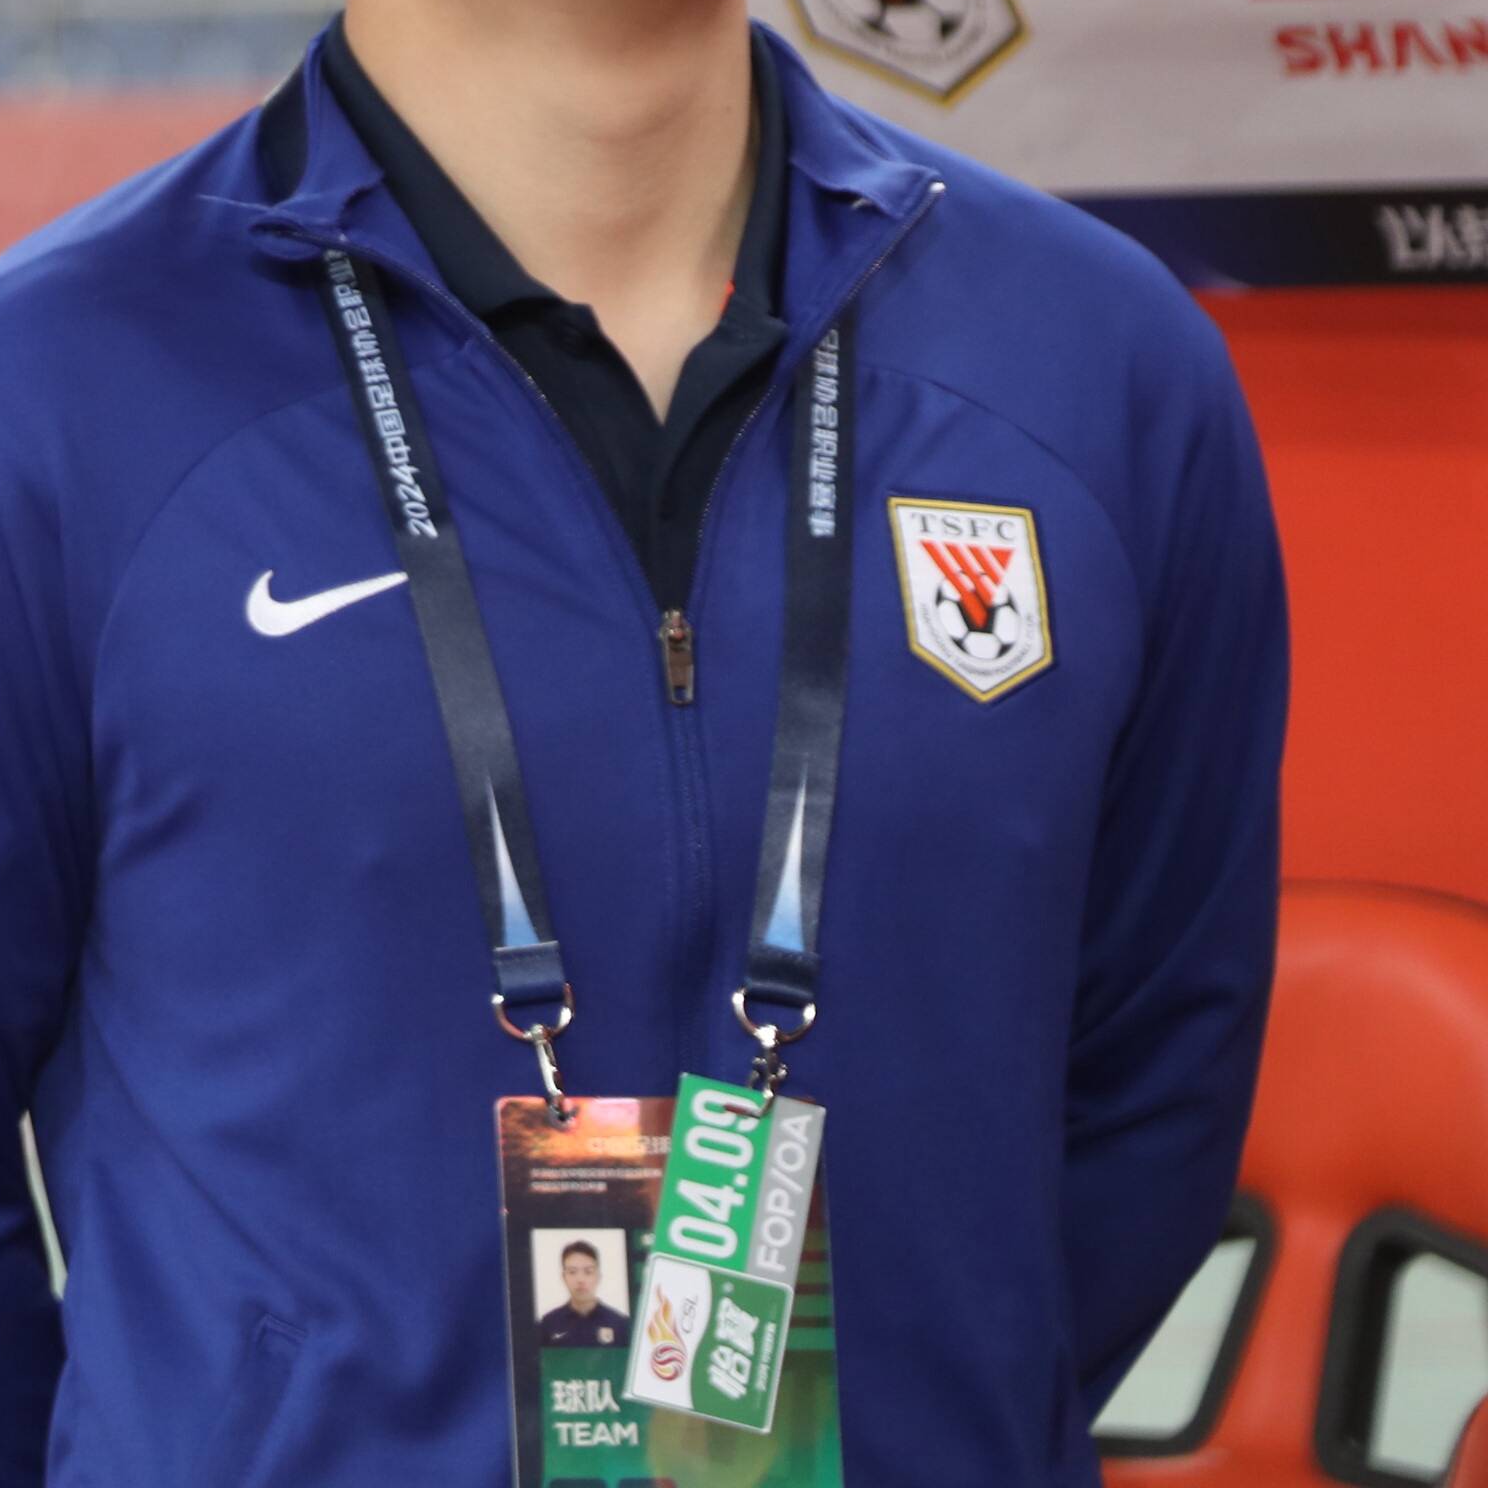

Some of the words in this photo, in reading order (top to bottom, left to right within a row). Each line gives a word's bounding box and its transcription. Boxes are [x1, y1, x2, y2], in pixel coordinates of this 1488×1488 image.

[911, 511, 1016, 542] TSFC
[667, 1087, 764, 1261] 04.09
[757, 1113, 814, 1273] FOP/OA
[680, 1294, 699, 1336] CSL
[551, 1379, 621, 1413] 球队
[554, 1422, 639, 1447] TEAM
